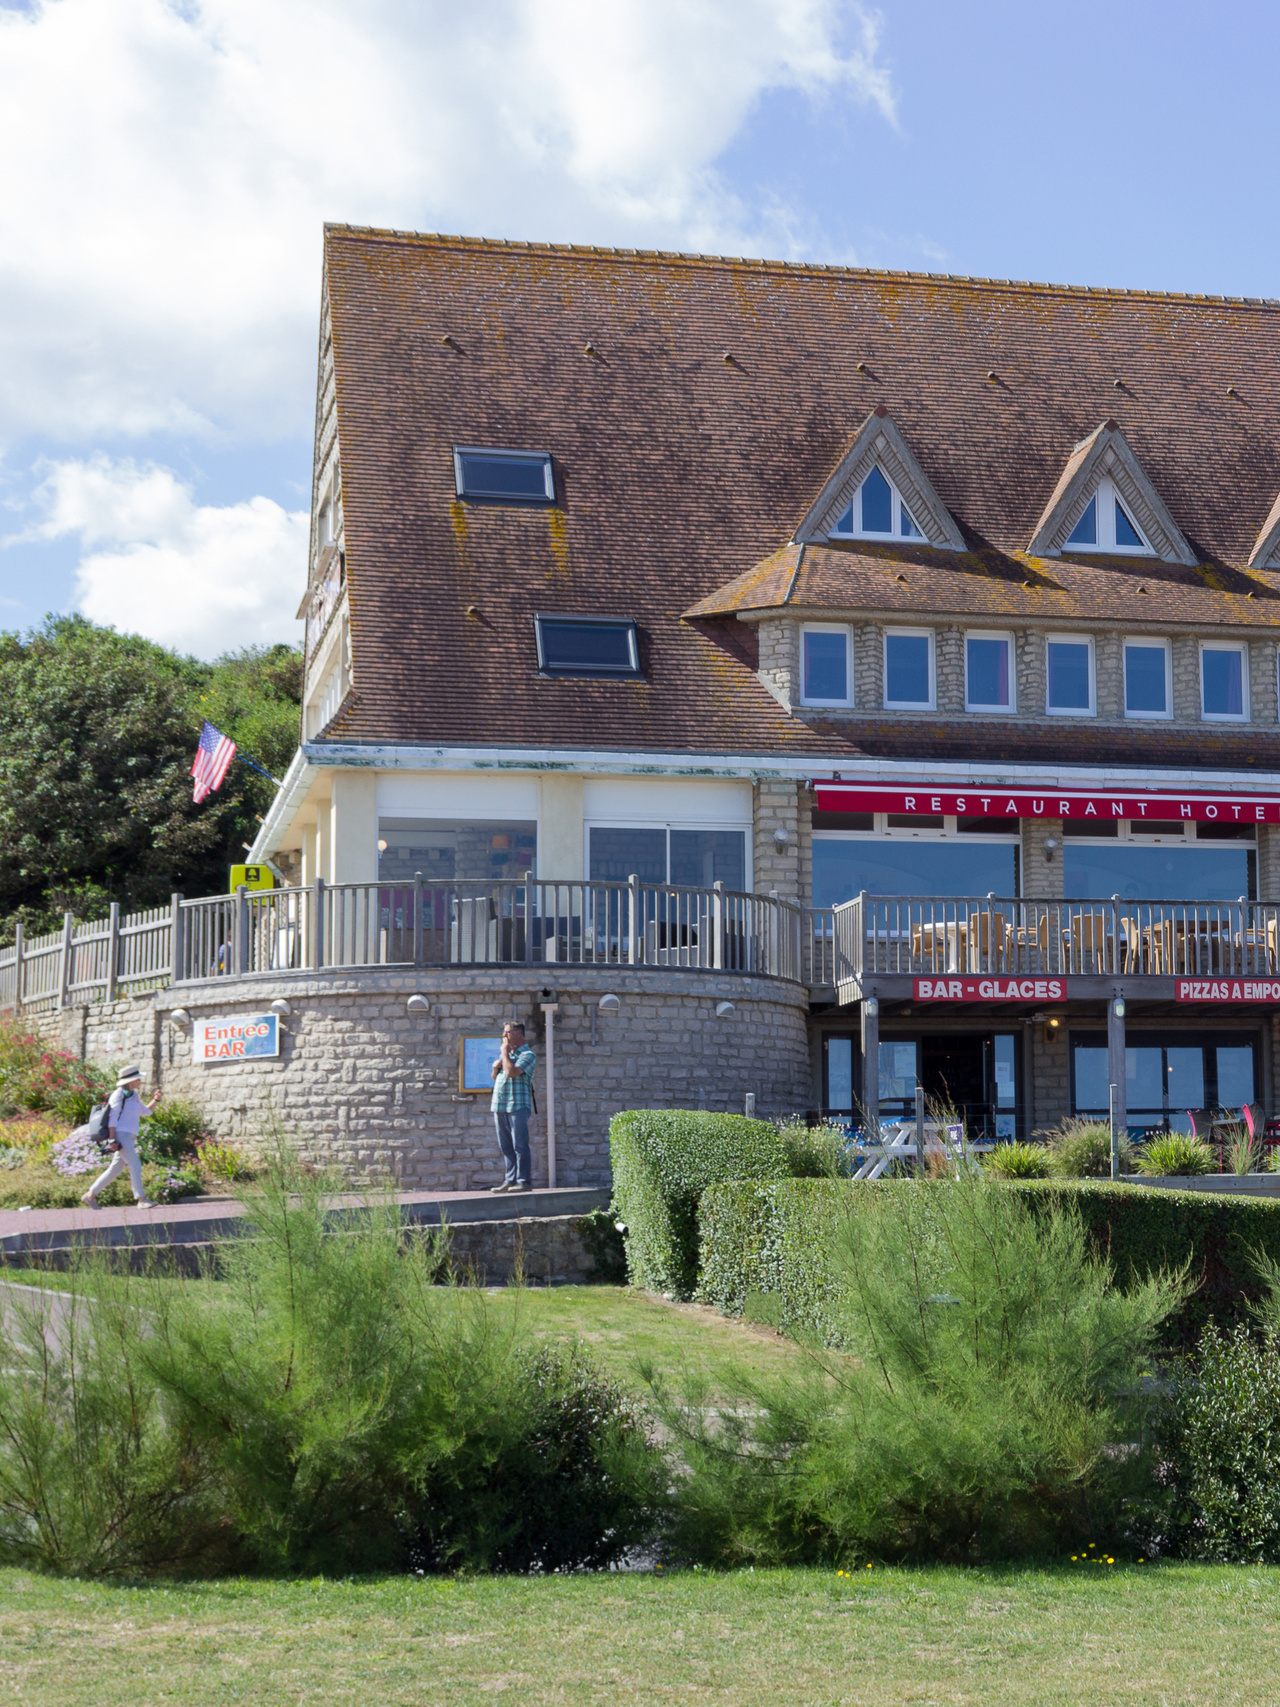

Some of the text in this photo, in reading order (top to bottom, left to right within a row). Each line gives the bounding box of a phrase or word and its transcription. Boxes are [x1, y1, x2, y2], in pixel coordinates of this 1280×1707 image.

[904, 796, 1148, 816] RESTAURANT
[918, 980, 963, 998] BAR
[978, 980, 1062, 999] GLACES
[1180, 982, 1229, 999] PIZZAS
[1231, 982, 1242, 999] A
[204, 1041, 245, 1058] BAR
